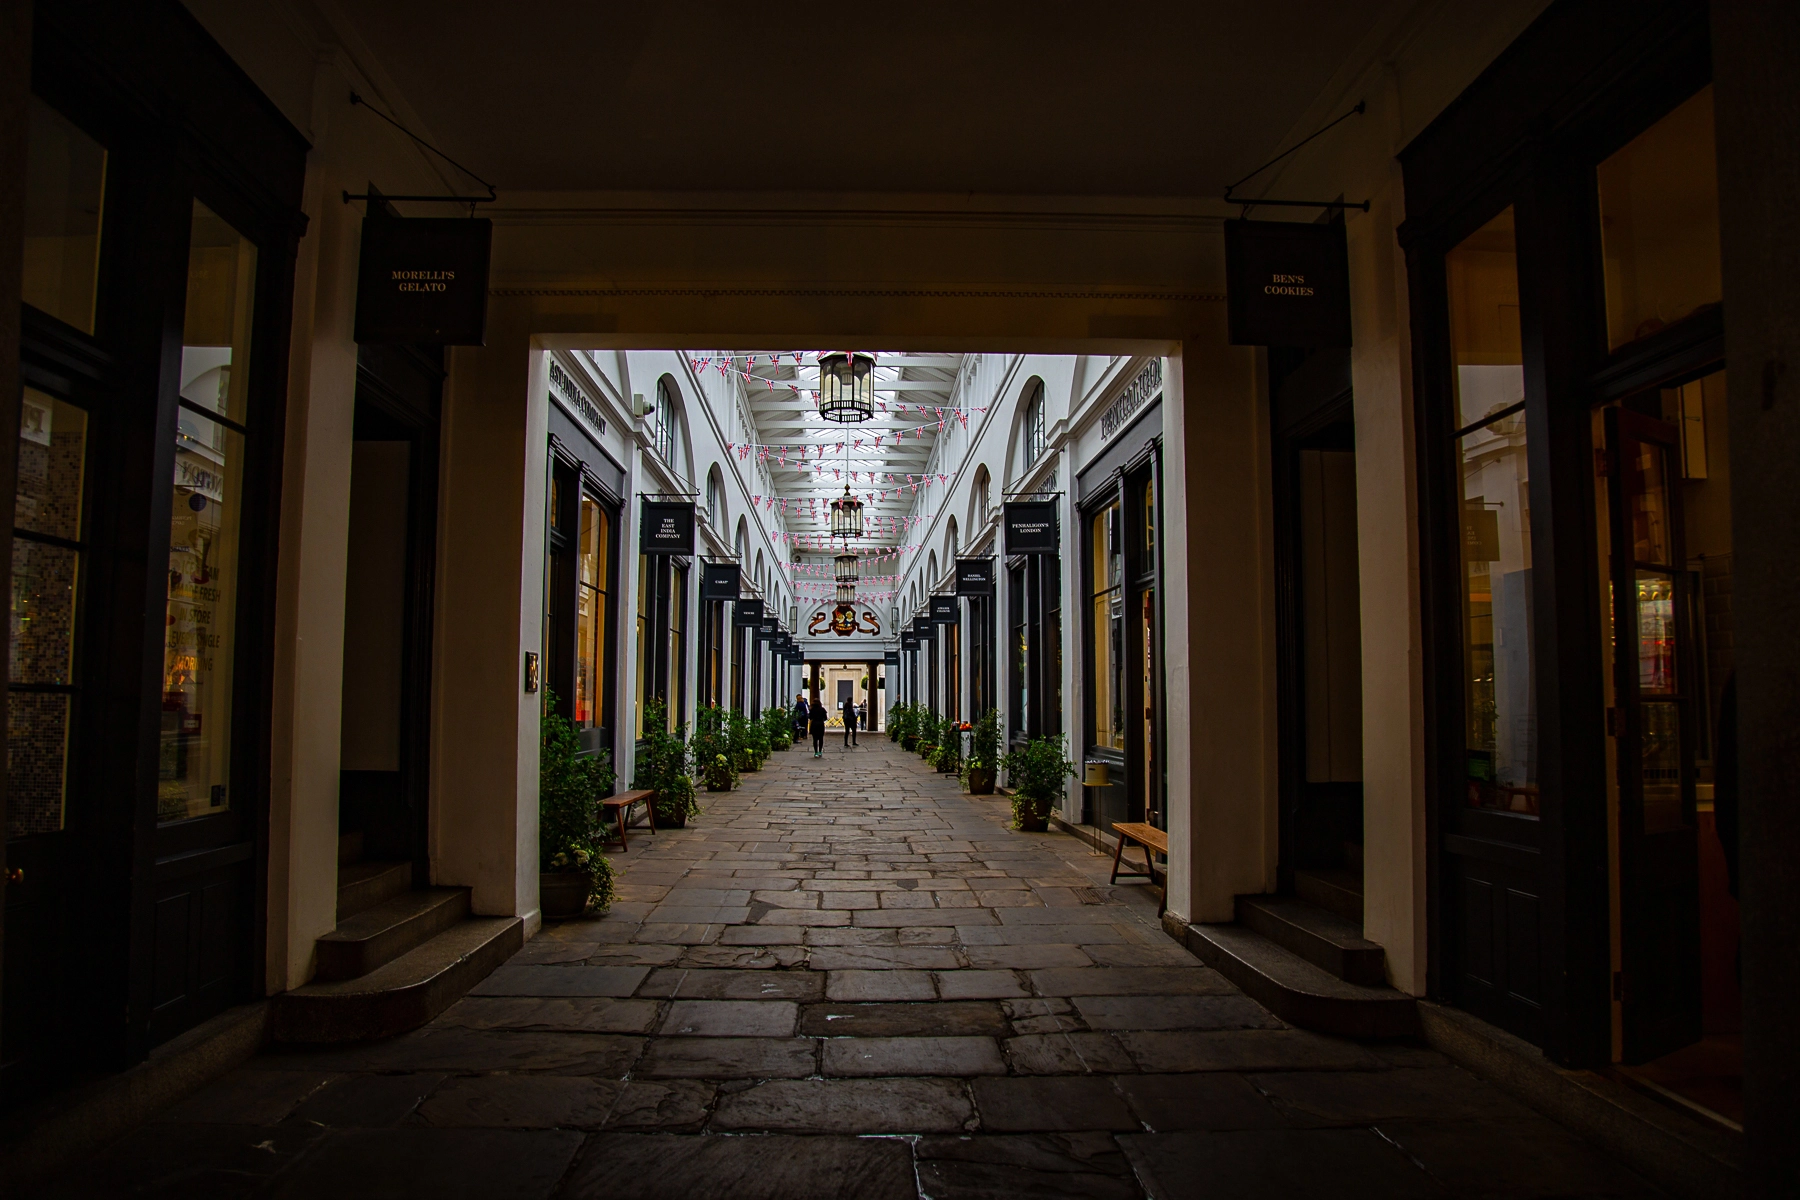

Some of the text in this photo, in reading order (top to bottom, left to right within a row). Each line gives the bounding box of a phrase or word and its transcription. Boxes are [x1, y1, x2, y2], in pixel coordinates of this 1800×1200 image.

[391, 270, 455, 280] MORELLI'S
[1272, 274, 1305, 284] BEN'S
[398, 282, 447, 292] GELATO
[1264, 285, 1314, 296] COOKIES
[549, 359, 607, 435] AST INDIA COMPANY
[199, 587, 221, 602] FRESH
[189, 608, 211, 625] STORE
[196, 634, 220, 648] SINGLE
[176, 656, 213, 671] MORNING
